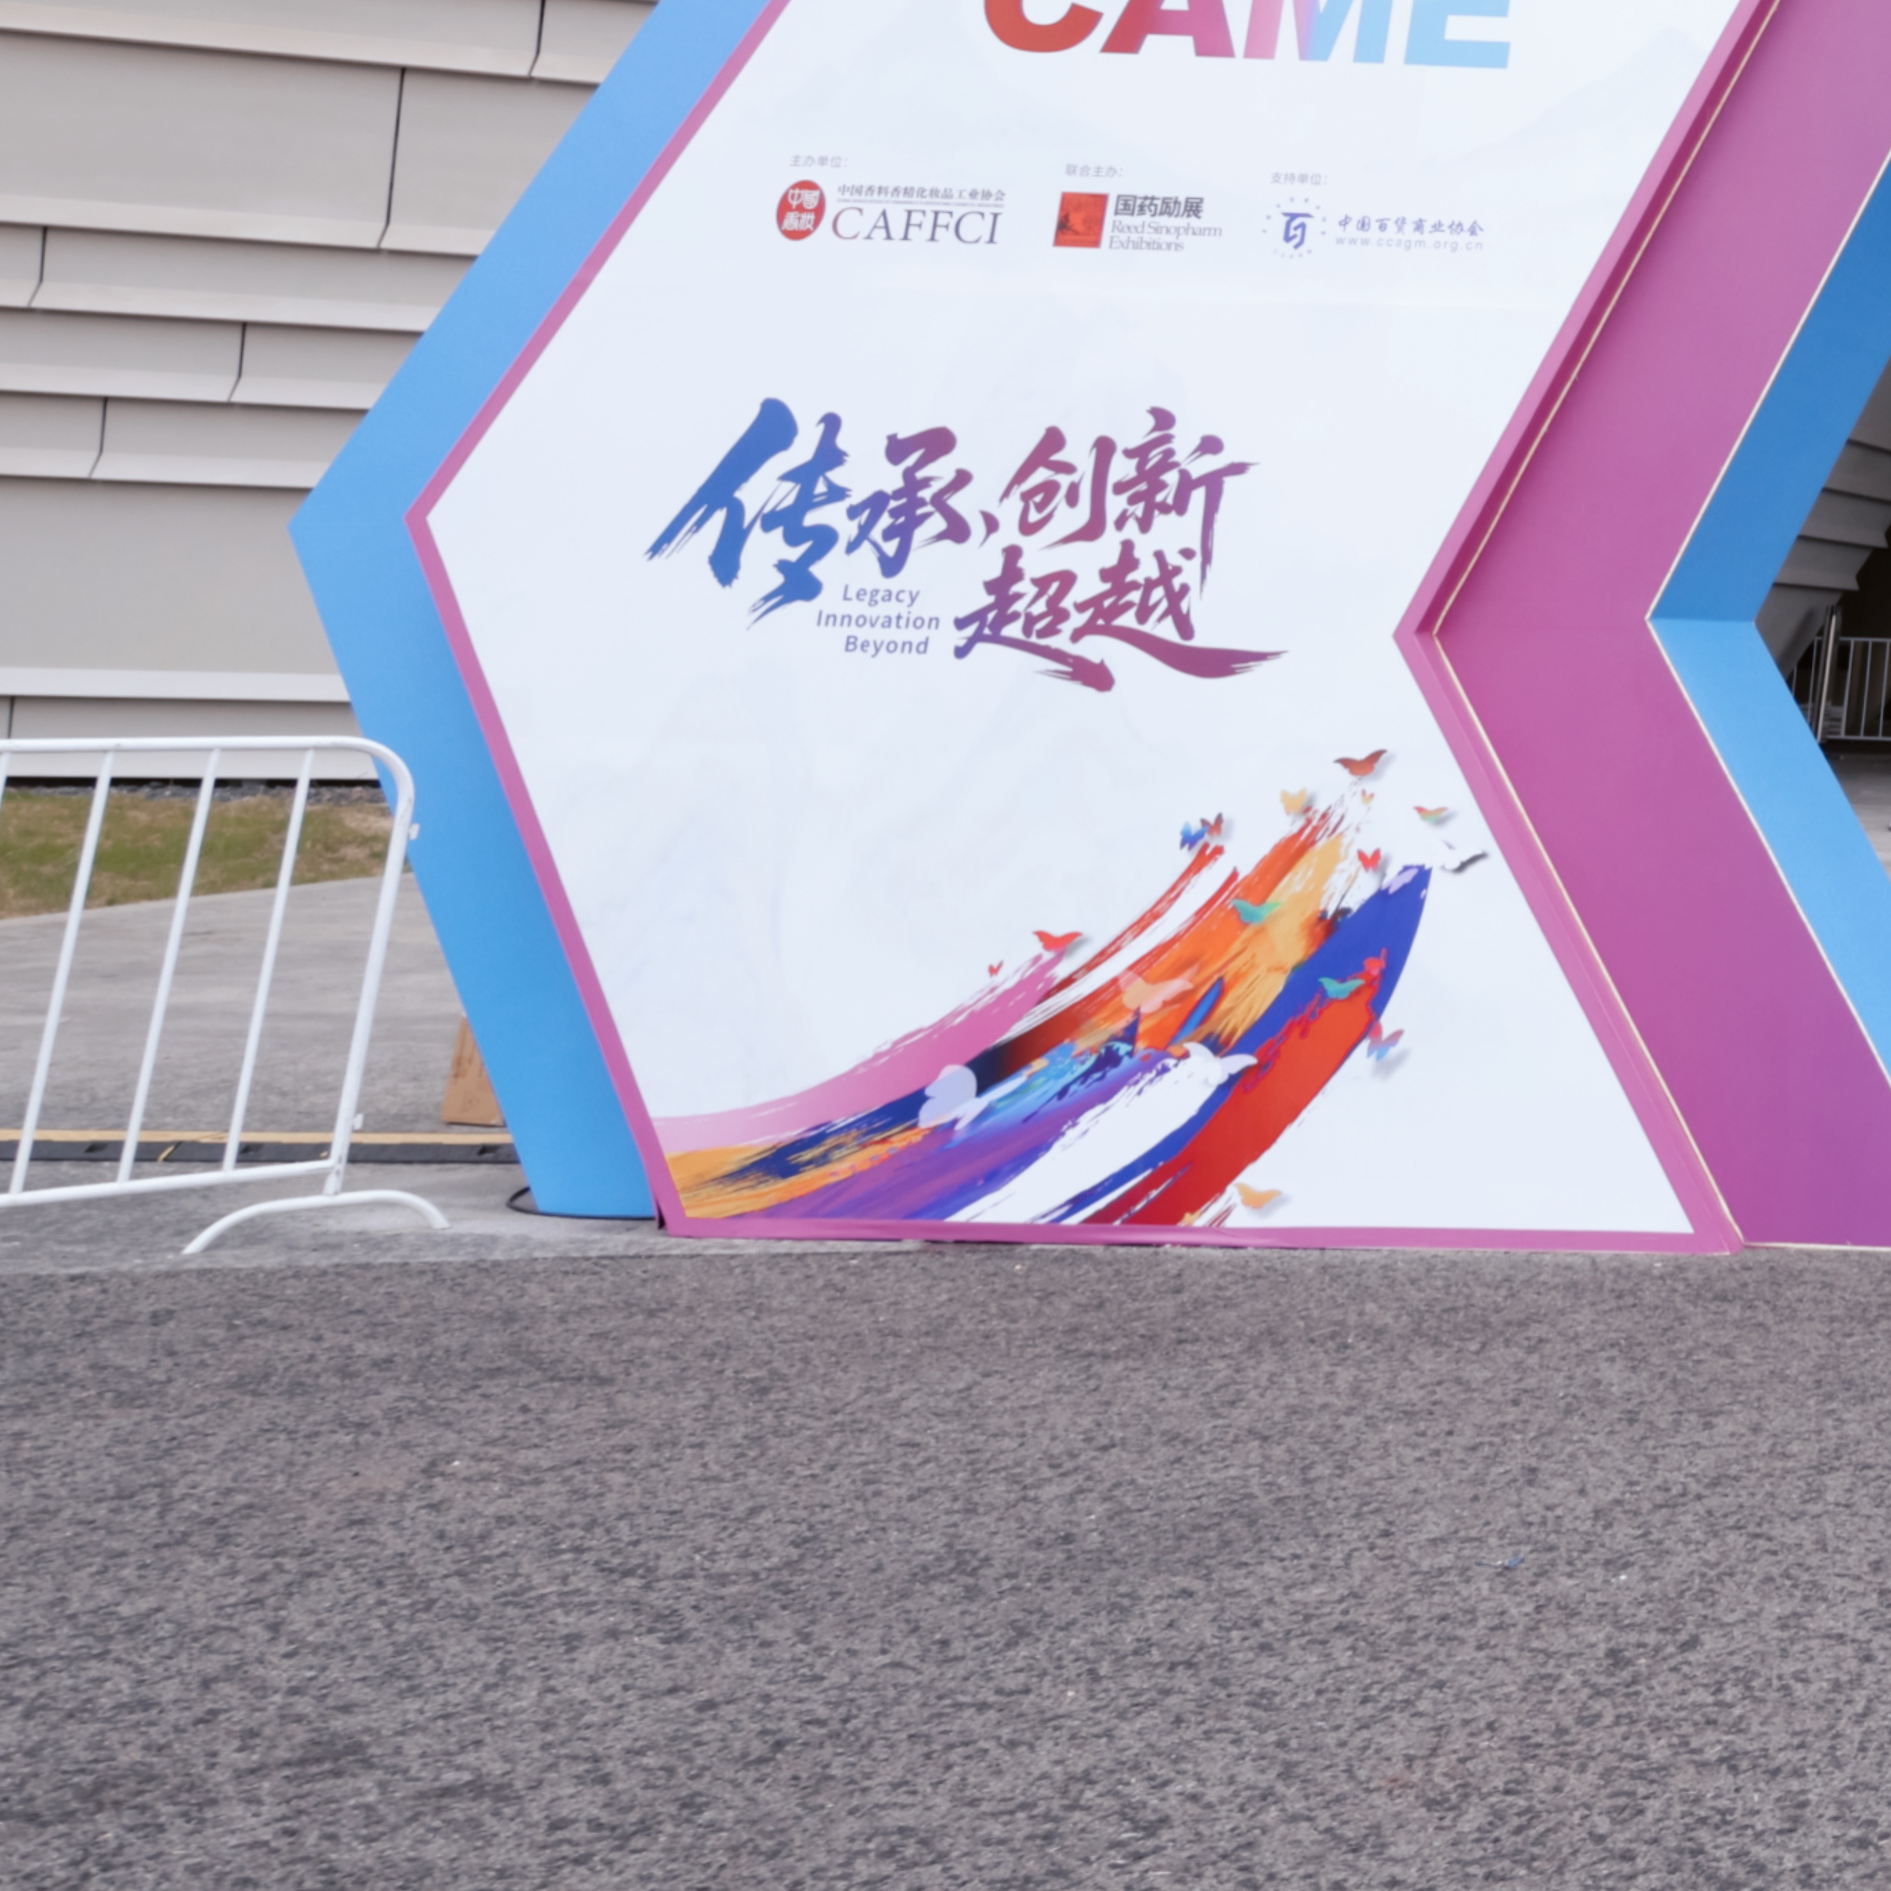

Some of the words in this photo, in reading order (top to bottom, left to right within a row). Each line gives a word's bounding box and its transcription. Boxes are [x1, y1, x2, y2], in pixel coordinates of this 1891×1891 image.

[837, 184, 1006, 202] 中国香料香精化妆品工业协会
[1113, 194, 1205, 219] 国药励展
[831, 206, 1003, 245] CAFFCI
[1111, 220, 1145, 235] Reed
[1147, 222, 1222, 238] Sinopharm
[1338, 213, 1484, 237] 中国百货商业协会
[1108, 235, 1184, 252] Exhibitions
[842, 584, 921, 609] Legacy
[816, 610, 941, 630] Innovation
[953, 539, 1289, 693] 超越
[844, 634, 930, 659] Beyond
